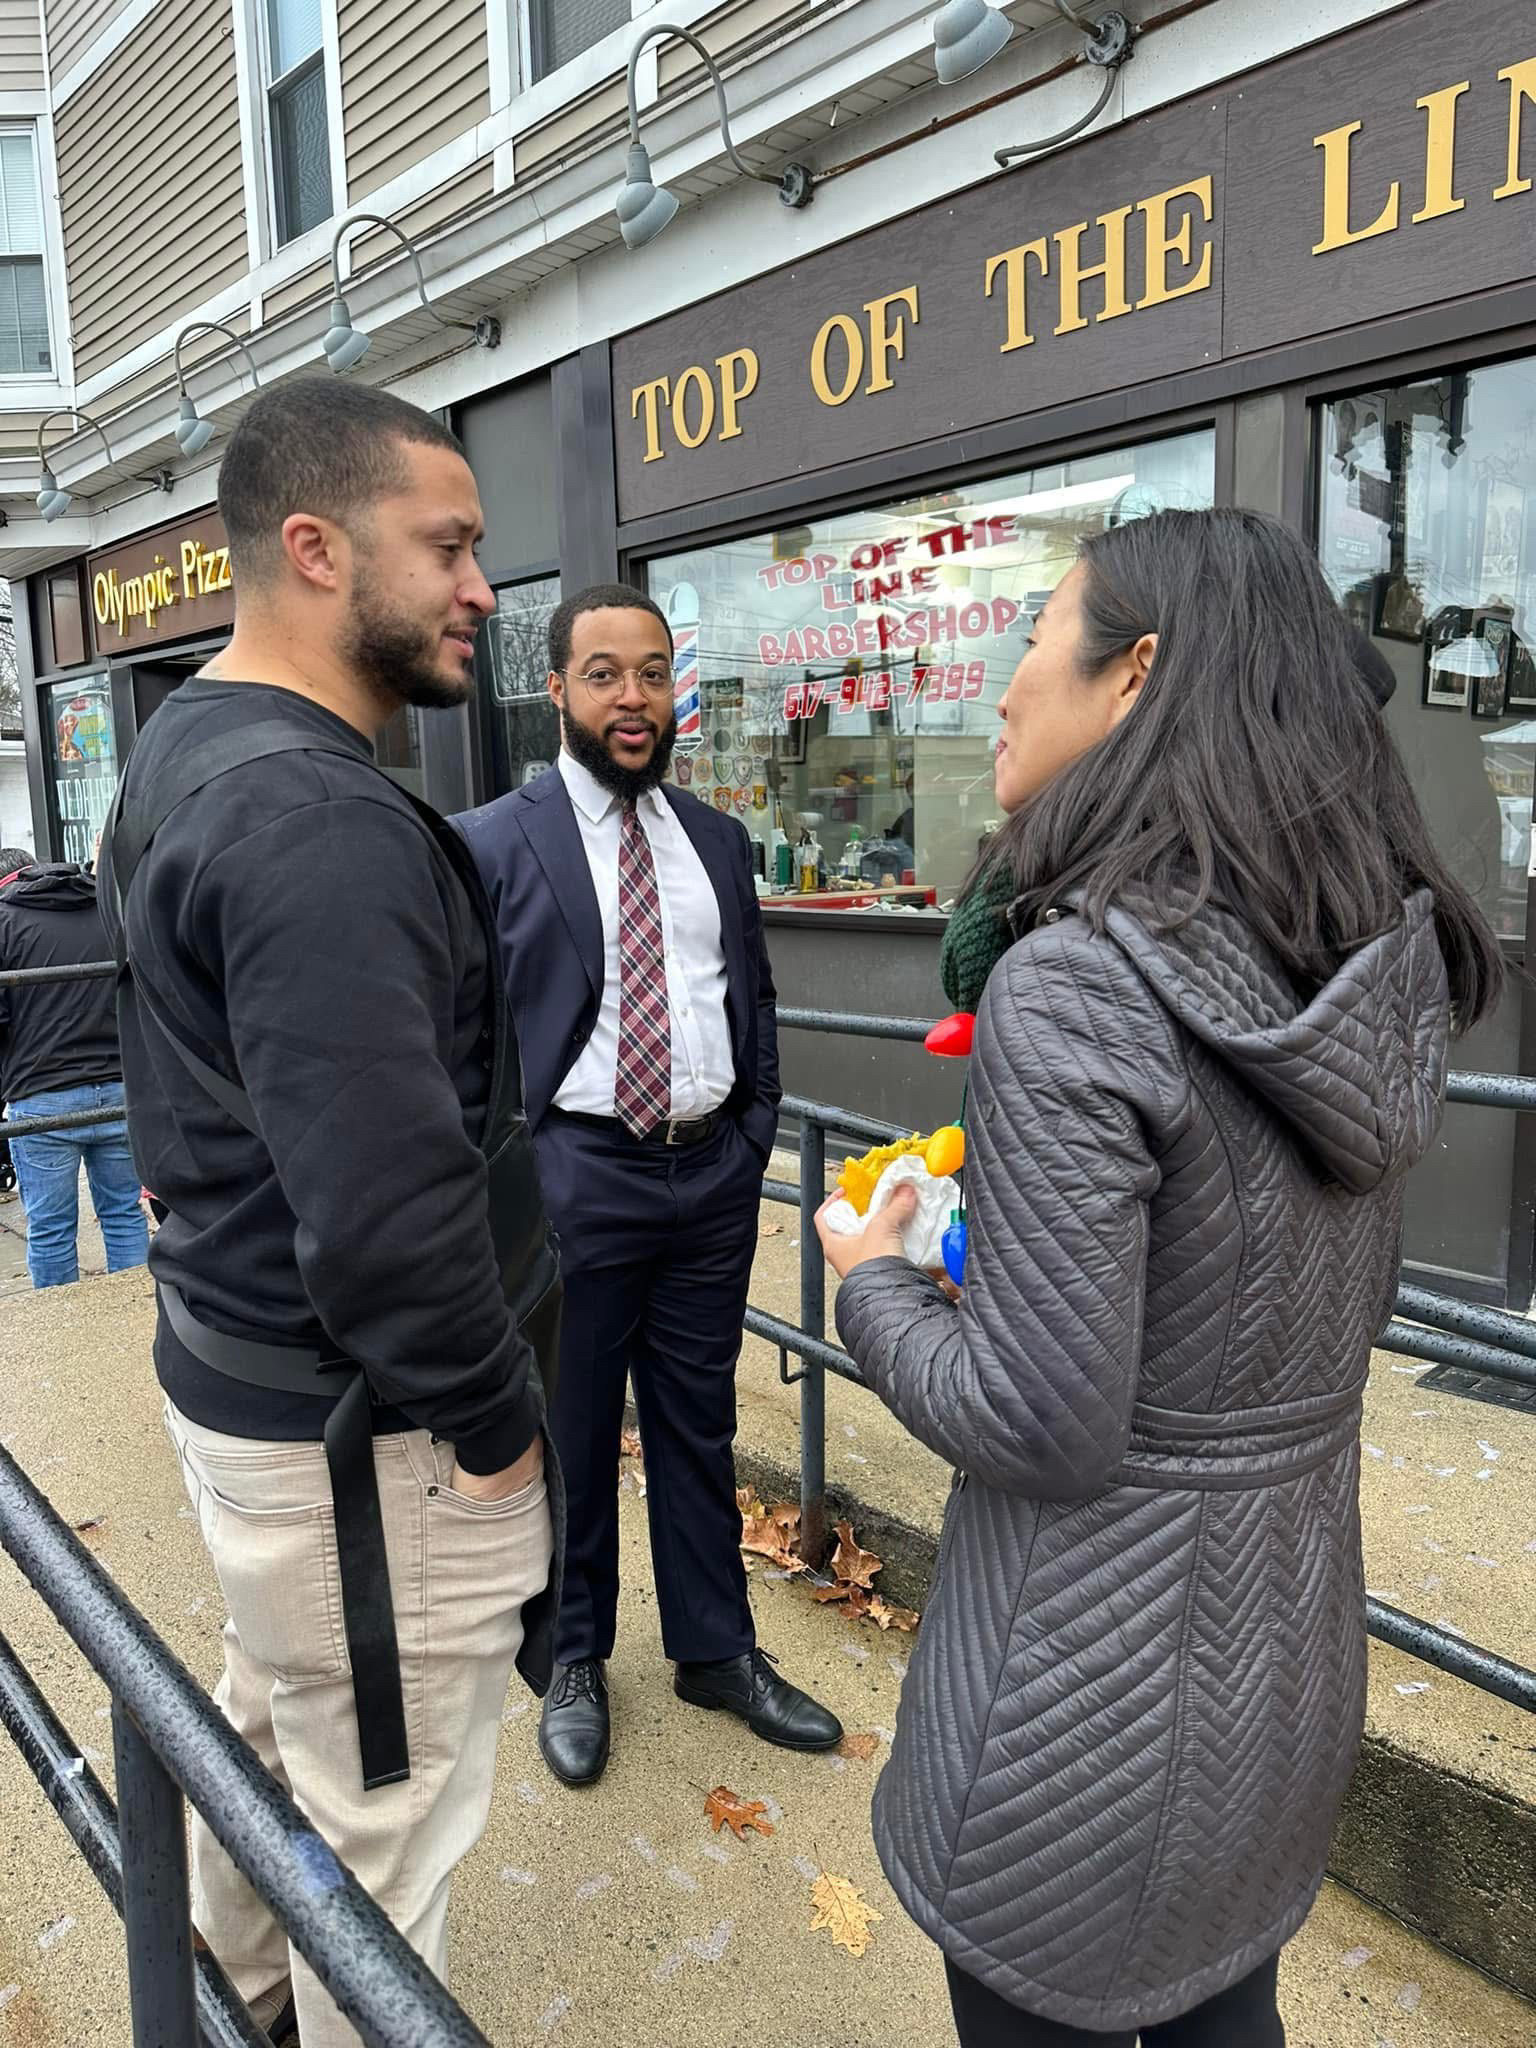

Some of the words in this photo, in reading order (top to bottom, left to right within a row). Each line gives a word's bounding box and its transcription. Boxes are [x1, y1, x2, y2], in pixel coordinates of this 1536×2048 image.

[632, 346, 760, 464] TOP
[809, 284, 921, 408] OF
[984, 174, 1214, 354] THE
[94, 554, 179, 636] Olympic
[180, 539, 234, 600] Pizz
[757, 552, 838, 592] TOP
[849, 534, 913, 571] OF
[917, 513, 1022, 560] THE
[821, 564, 943, 612] LINE
[757, 596, 1020, 668] BARBERSHOP
[783, 659, 987, 721] 617-942-7399
